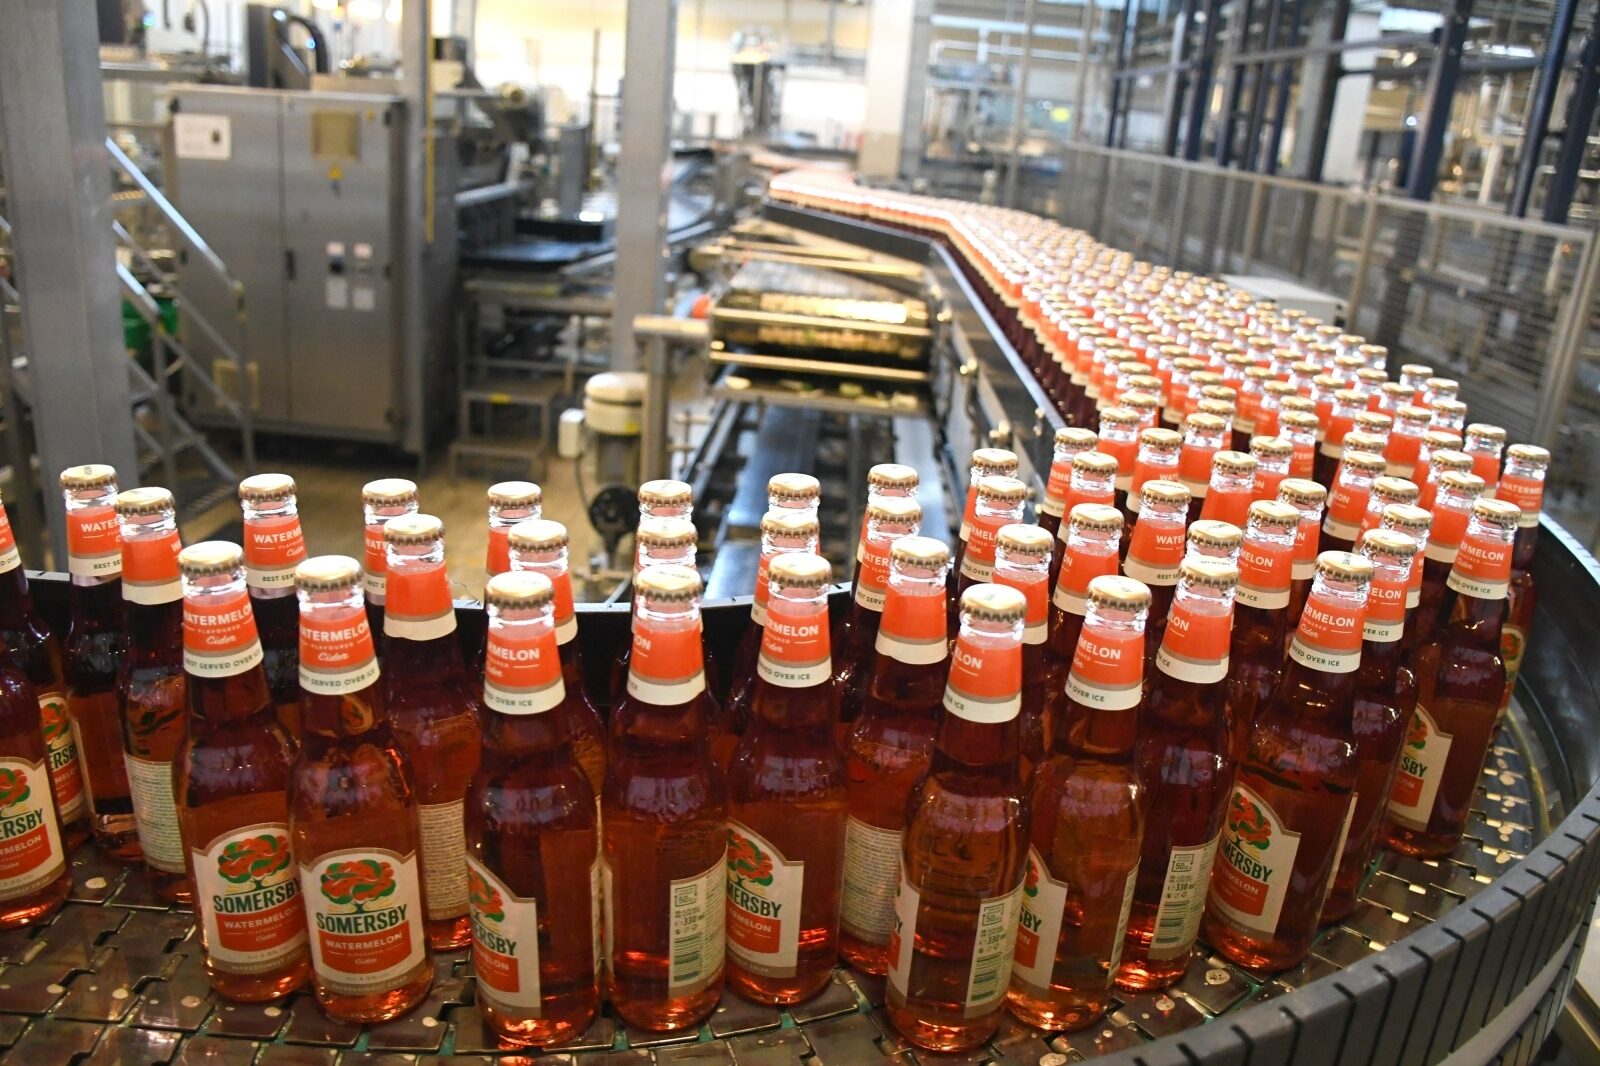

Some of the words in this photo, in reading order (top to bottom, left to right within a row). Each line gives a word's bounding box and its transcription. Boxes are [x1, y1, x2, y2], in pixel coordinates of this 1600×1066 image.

[1306, 654, 1326, 665] OVER
[199, 662, 231, 670] SERVED
[1091, 694, 1105, 703] ICE
[316, 904, 407, 935] SOMERSBY
[324, 932, 403, 950] WATERMELON
